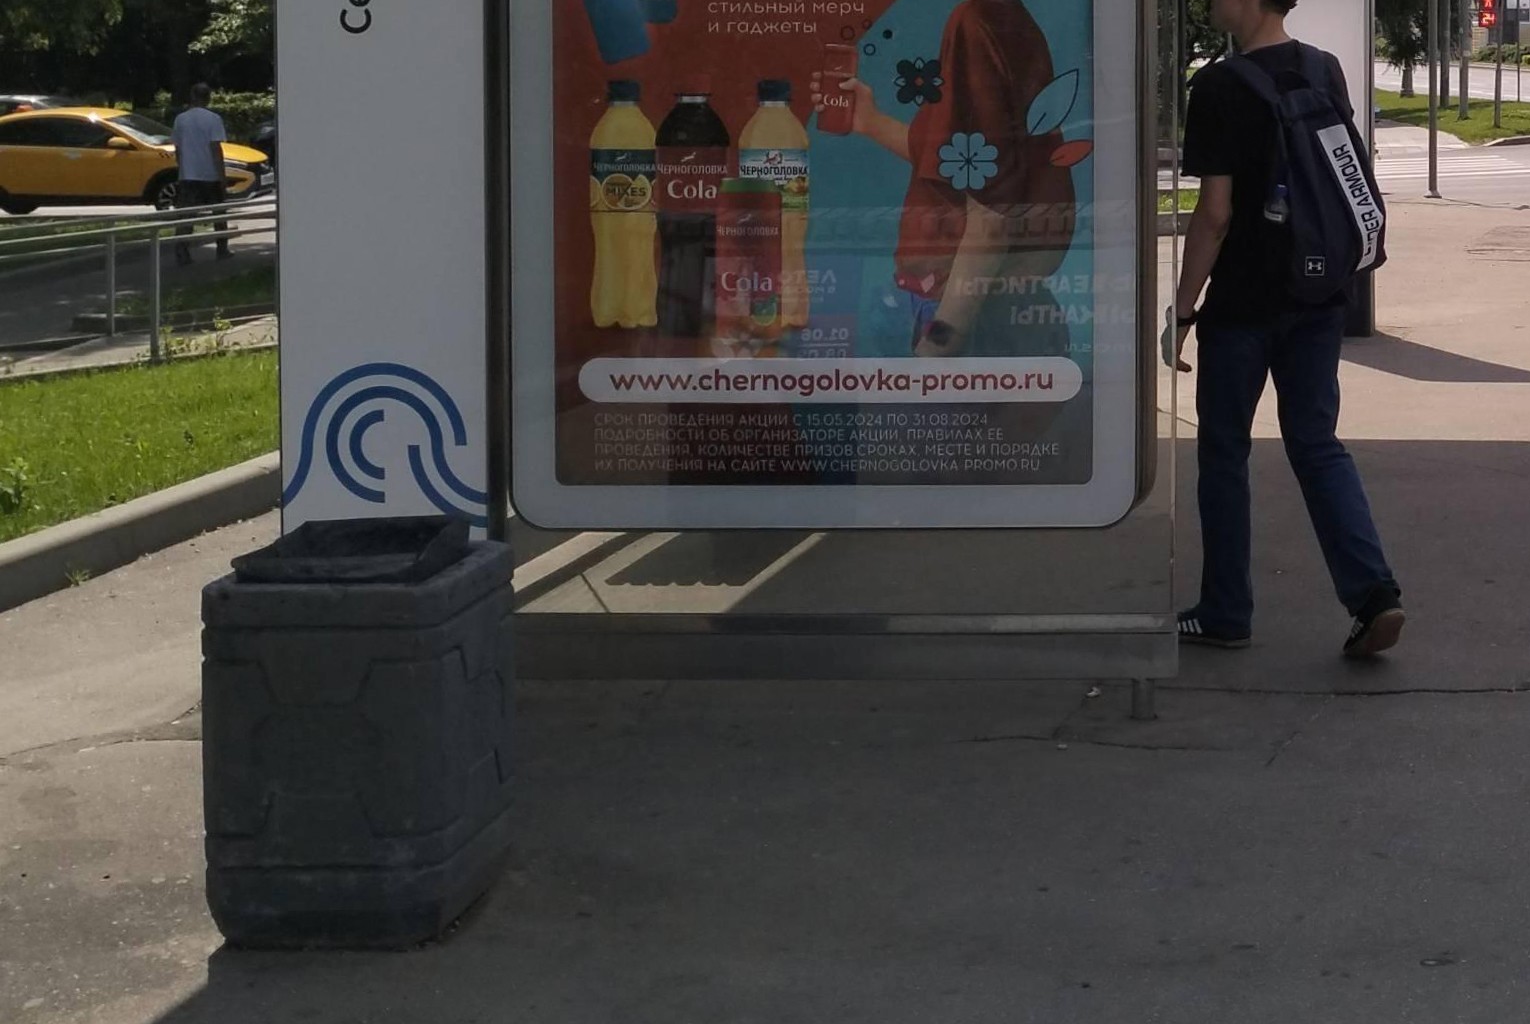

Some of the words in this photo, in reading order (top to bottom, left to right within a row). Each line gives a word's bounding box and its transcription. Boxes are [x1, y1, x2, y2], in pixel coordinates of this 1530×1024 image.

[707, 0, 805, 14] стильный
[812, 2, 865, 16] мерч
[708, 22, 719, 33] и
[726, 21, 817, 34] гаджеты
[823, 94, 850, 108] Cola
[657, 163, 728, 175] ЧЕРНОГОЛОВКА
[740, 164, 808, 178] ЧЕРНОГОЛОВКА
[1332, 143, 1373, 207] ARMOUR
[667, 179, 717, 199] Cola
[720, 271, 773, 292] Cola
[610, 368, 1054, 396] www.chernogolovka-promo.ru
[594, 414, 633, 426] СРОК
[638, 414, 735, 427] ПРОВЕДЕНИЯ
[739, 414, 788, 427] АКЦИИ
[886, 414, 908, 426] ПО
[594, 428, 704, 442] ПОДРОБНОСТИ
[709, 428, 728, 441] ОБ
[733, 428, 844, 441] ОРГАНИЗАТОРЕ
[907, 428, 983, 441] ПРАВИЛАХ
[698, 443, 790, 456] КОЛИЧЕСТВЕ
[925, 443, 972, 456] МЕСТЕ
[977, 443, 985, 455] И
[990, 443, 1059, 456] ПОРЯДКЕ
[594, 459, 613, 472] ИХ
[618, 458, 703, 472] ПОЛУЧЕНИЯ
[708, 459, 726, 471] НА
[731, 457, 776, 471] САЙТЕ
